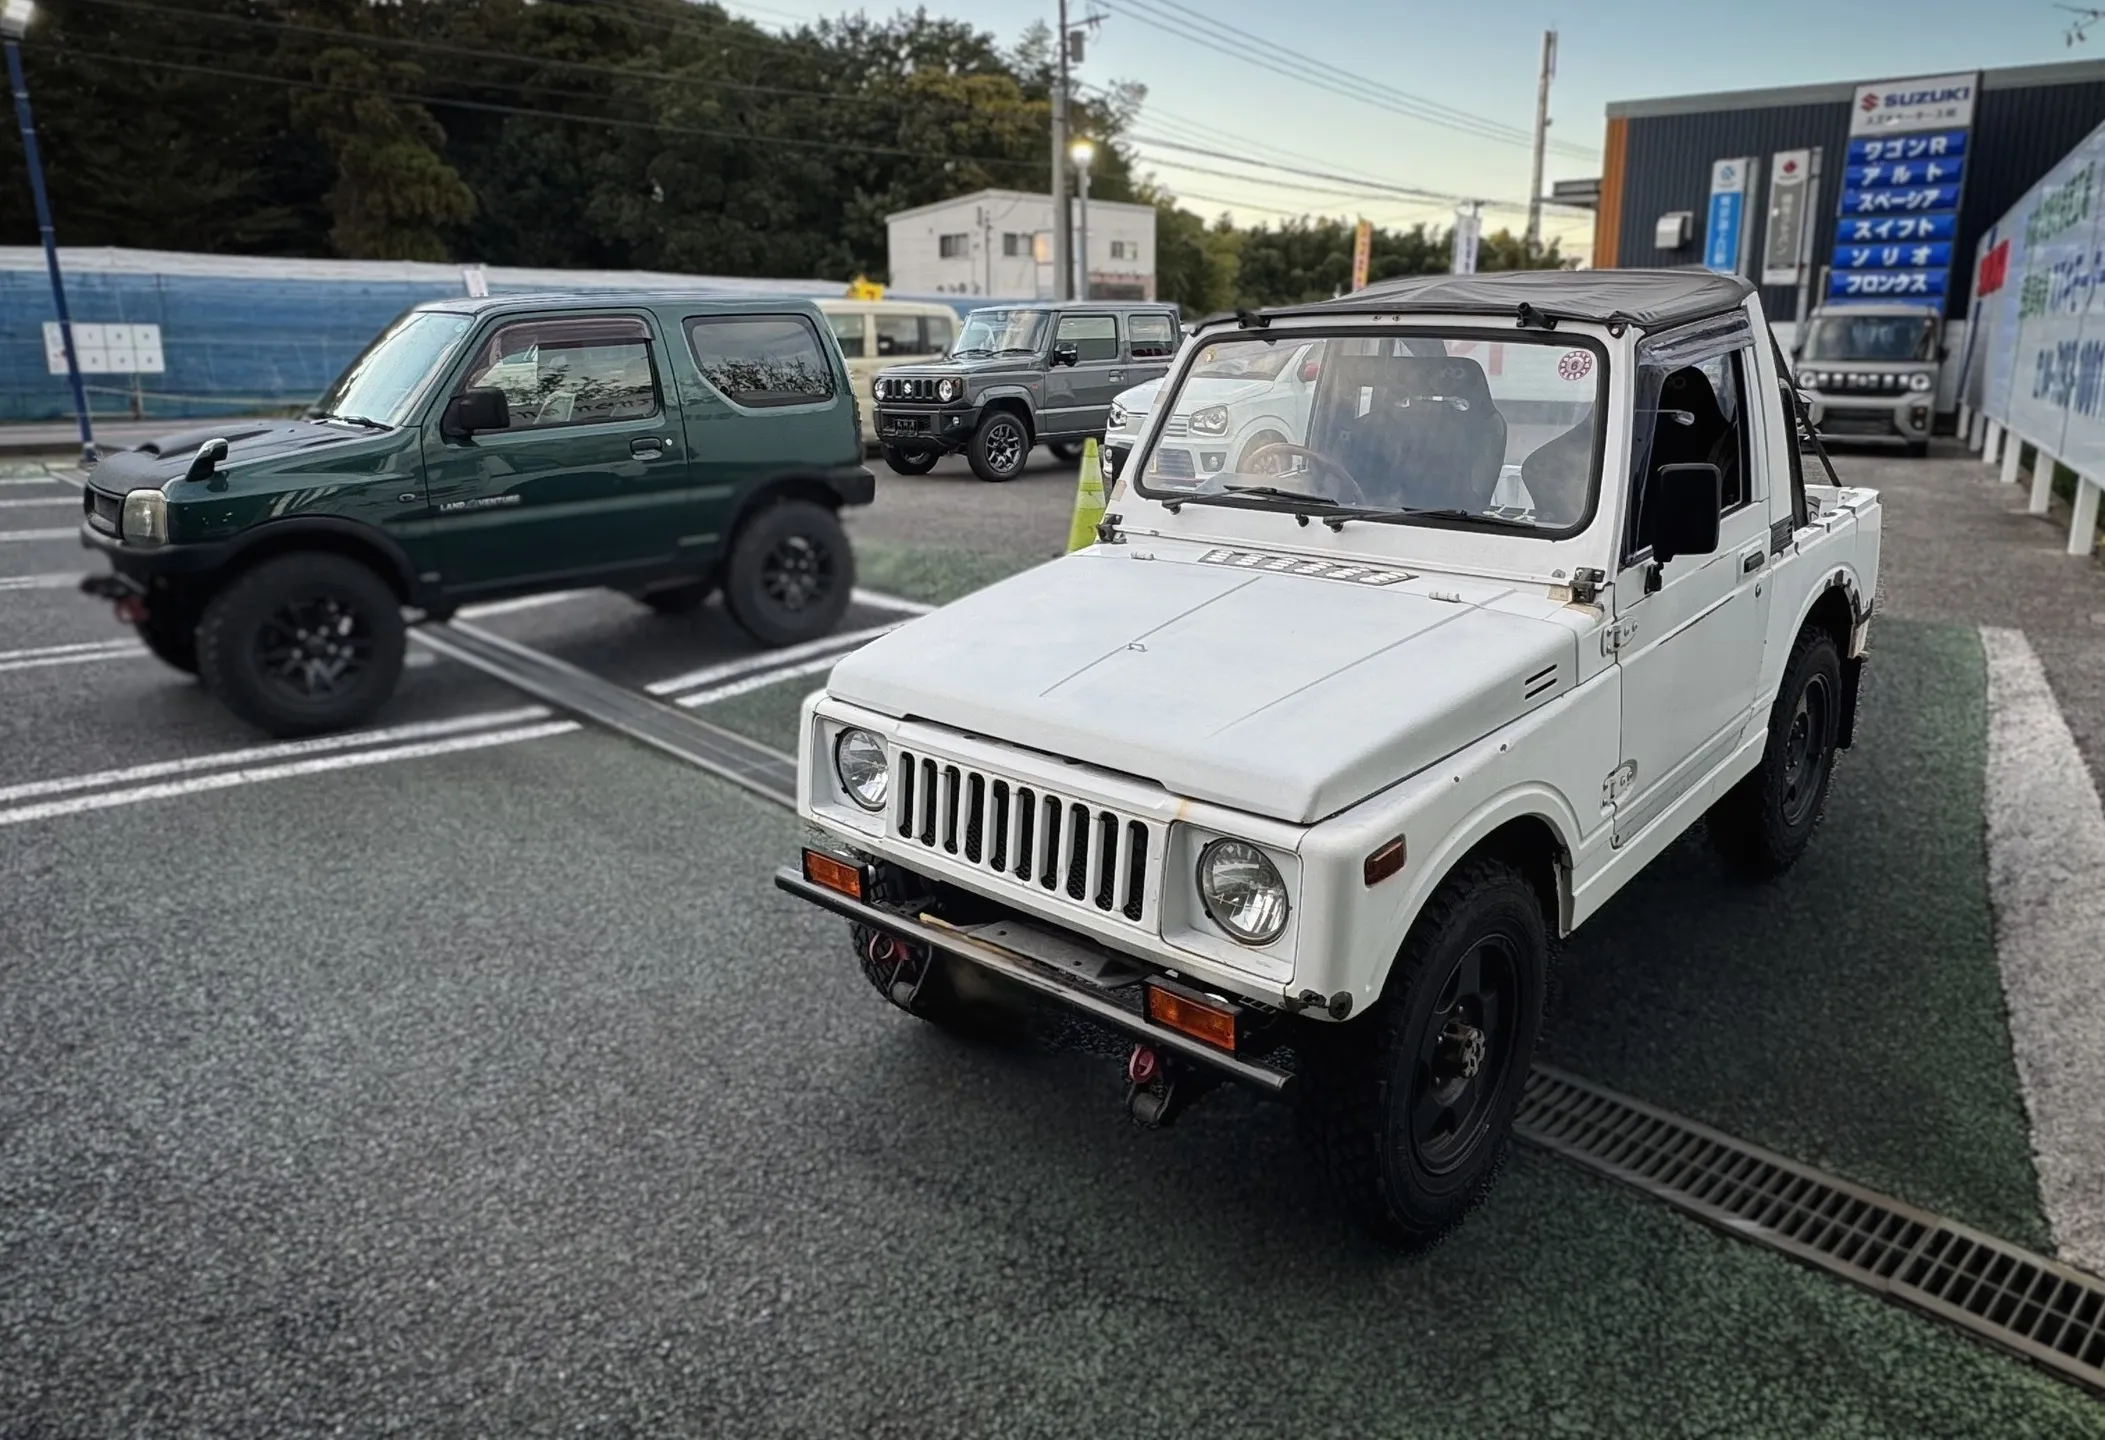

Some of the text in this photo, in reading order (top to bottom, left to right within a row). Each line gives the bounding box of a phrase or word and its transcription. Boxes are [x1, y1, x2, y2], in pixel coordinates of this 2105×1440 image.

[1884, 87, 1969, 107] SUZUKI
[1863, 136, 1948, 160] ワゴンR
[1861, 161, 1943, 187] アルト
[1857, 189, 1940, 212] スペーシア
[1854, 217, 1935, 239] スイフト
[1851, 245, 1932, 267] ソリオ
[1846, 272, 1928, 293] フロンクス
[440, 501, 466, 511] LAND
